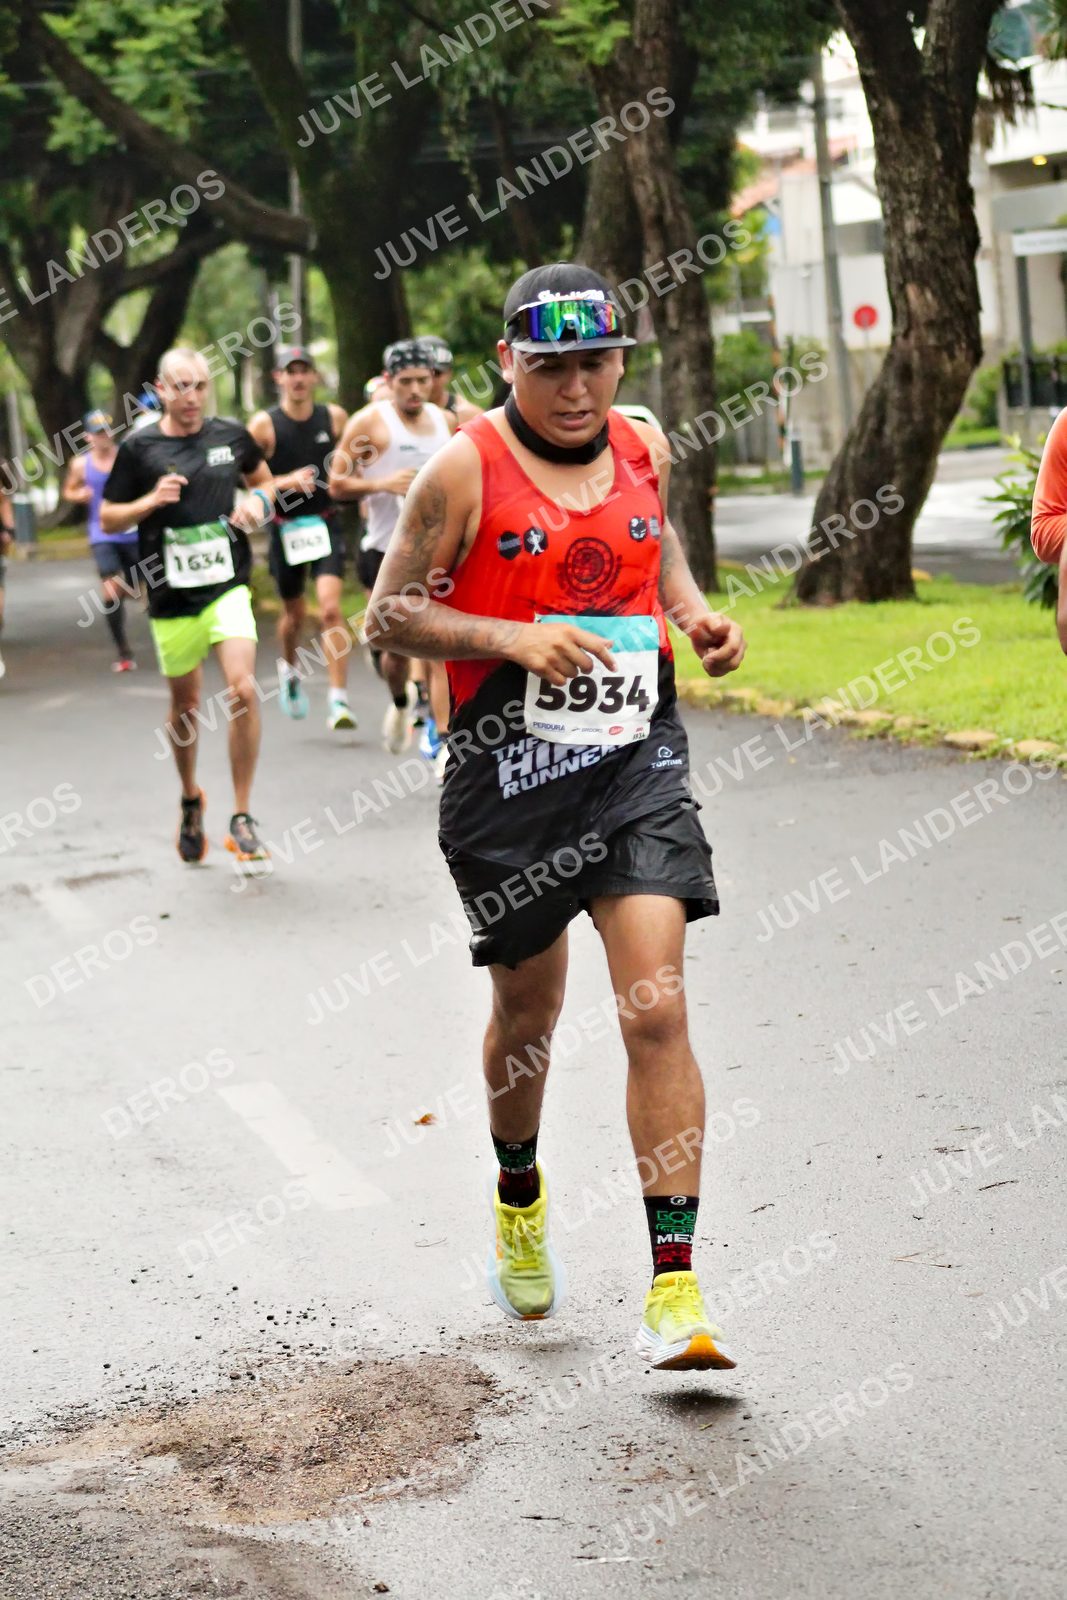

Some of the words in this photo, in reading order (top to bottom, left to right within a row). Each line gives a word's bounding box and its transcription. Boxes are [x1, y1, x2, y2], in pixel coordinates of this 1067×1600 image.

[174, 551, 225, 571] 1634
[535, 675, 650, 714] 5934
[491, 737, 540, 763] THE
